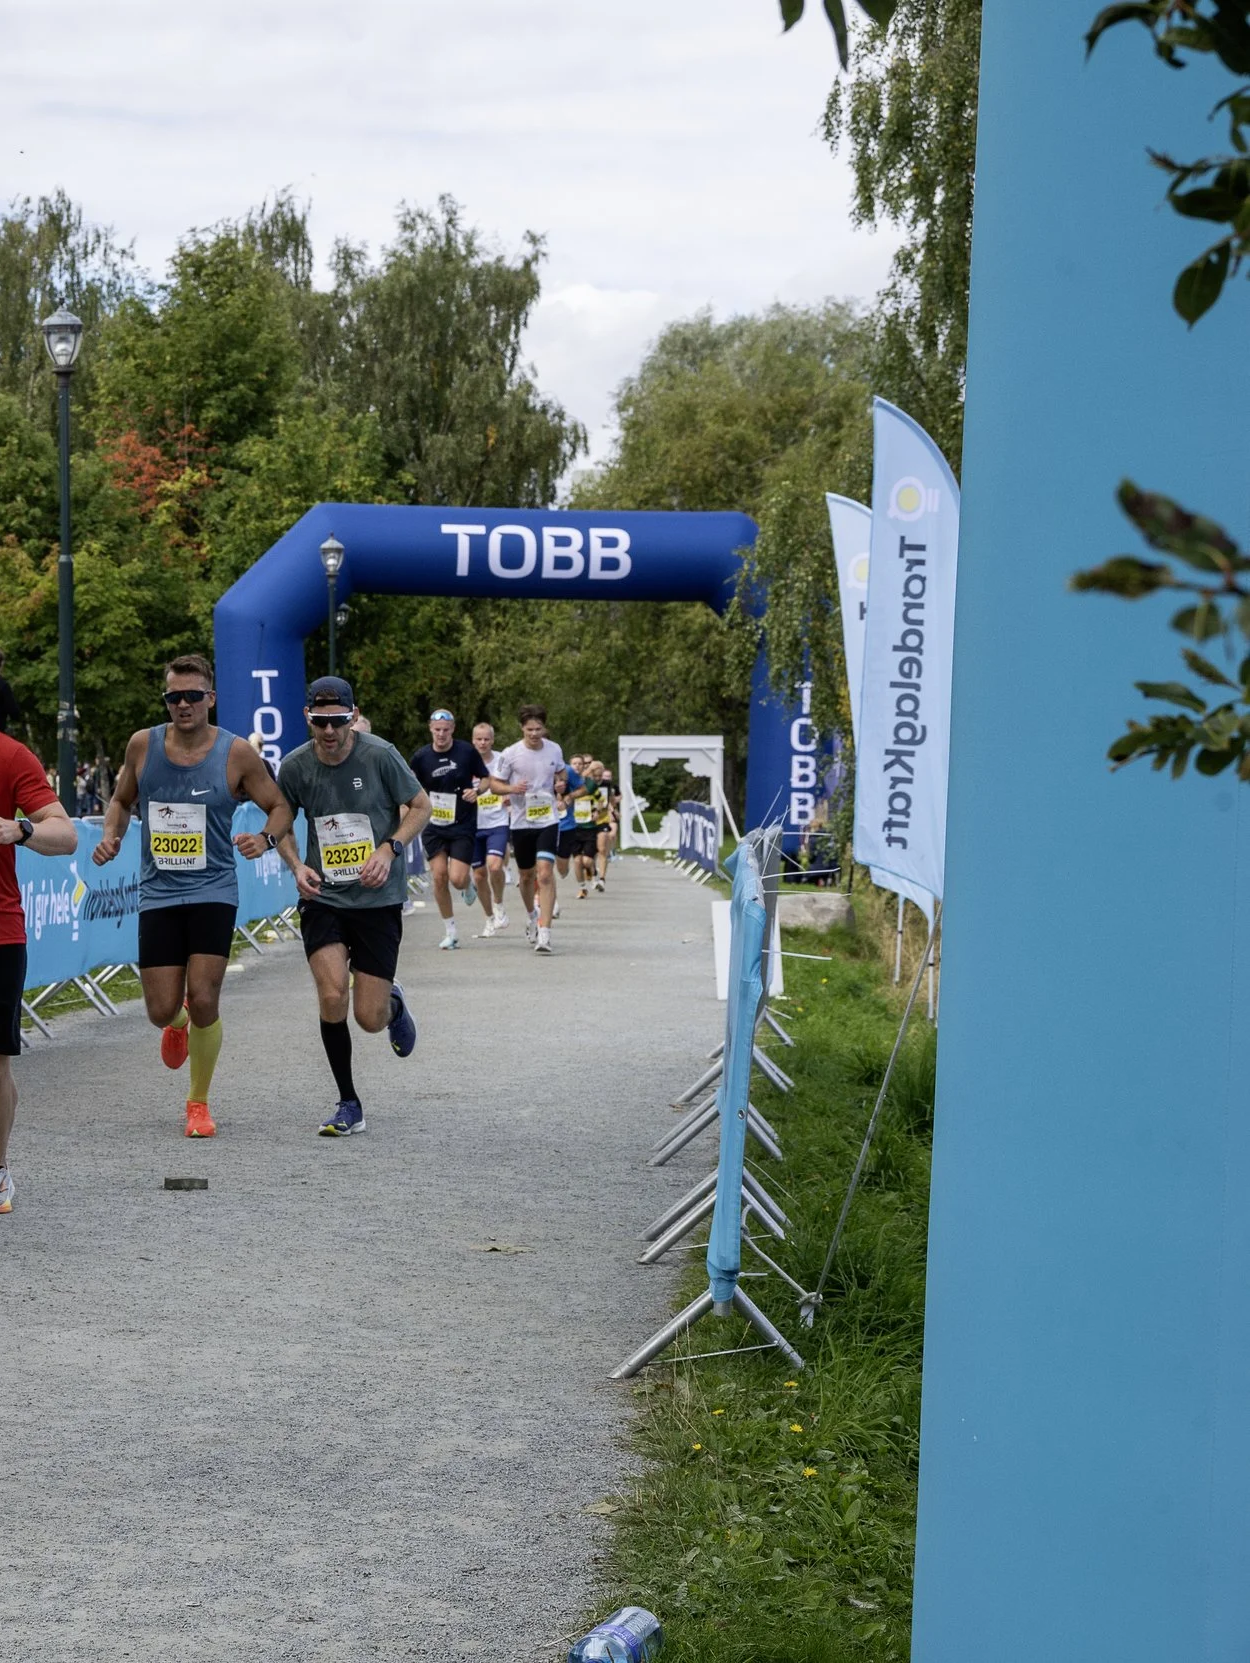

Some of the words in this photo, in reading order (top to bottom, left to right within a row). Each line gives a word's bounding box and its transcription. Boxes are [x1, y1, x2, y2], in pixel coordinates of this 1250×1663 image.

[441, 524, 632, 580] TOBB
[252, 669, 283, 780] TOB
[153, 837, 197, 853] 23022
[158, 857, 197, 866] BRILLIANT
[325, 846, 366, 865] 23237
[333, 867, 361, 877] BRILLIA
